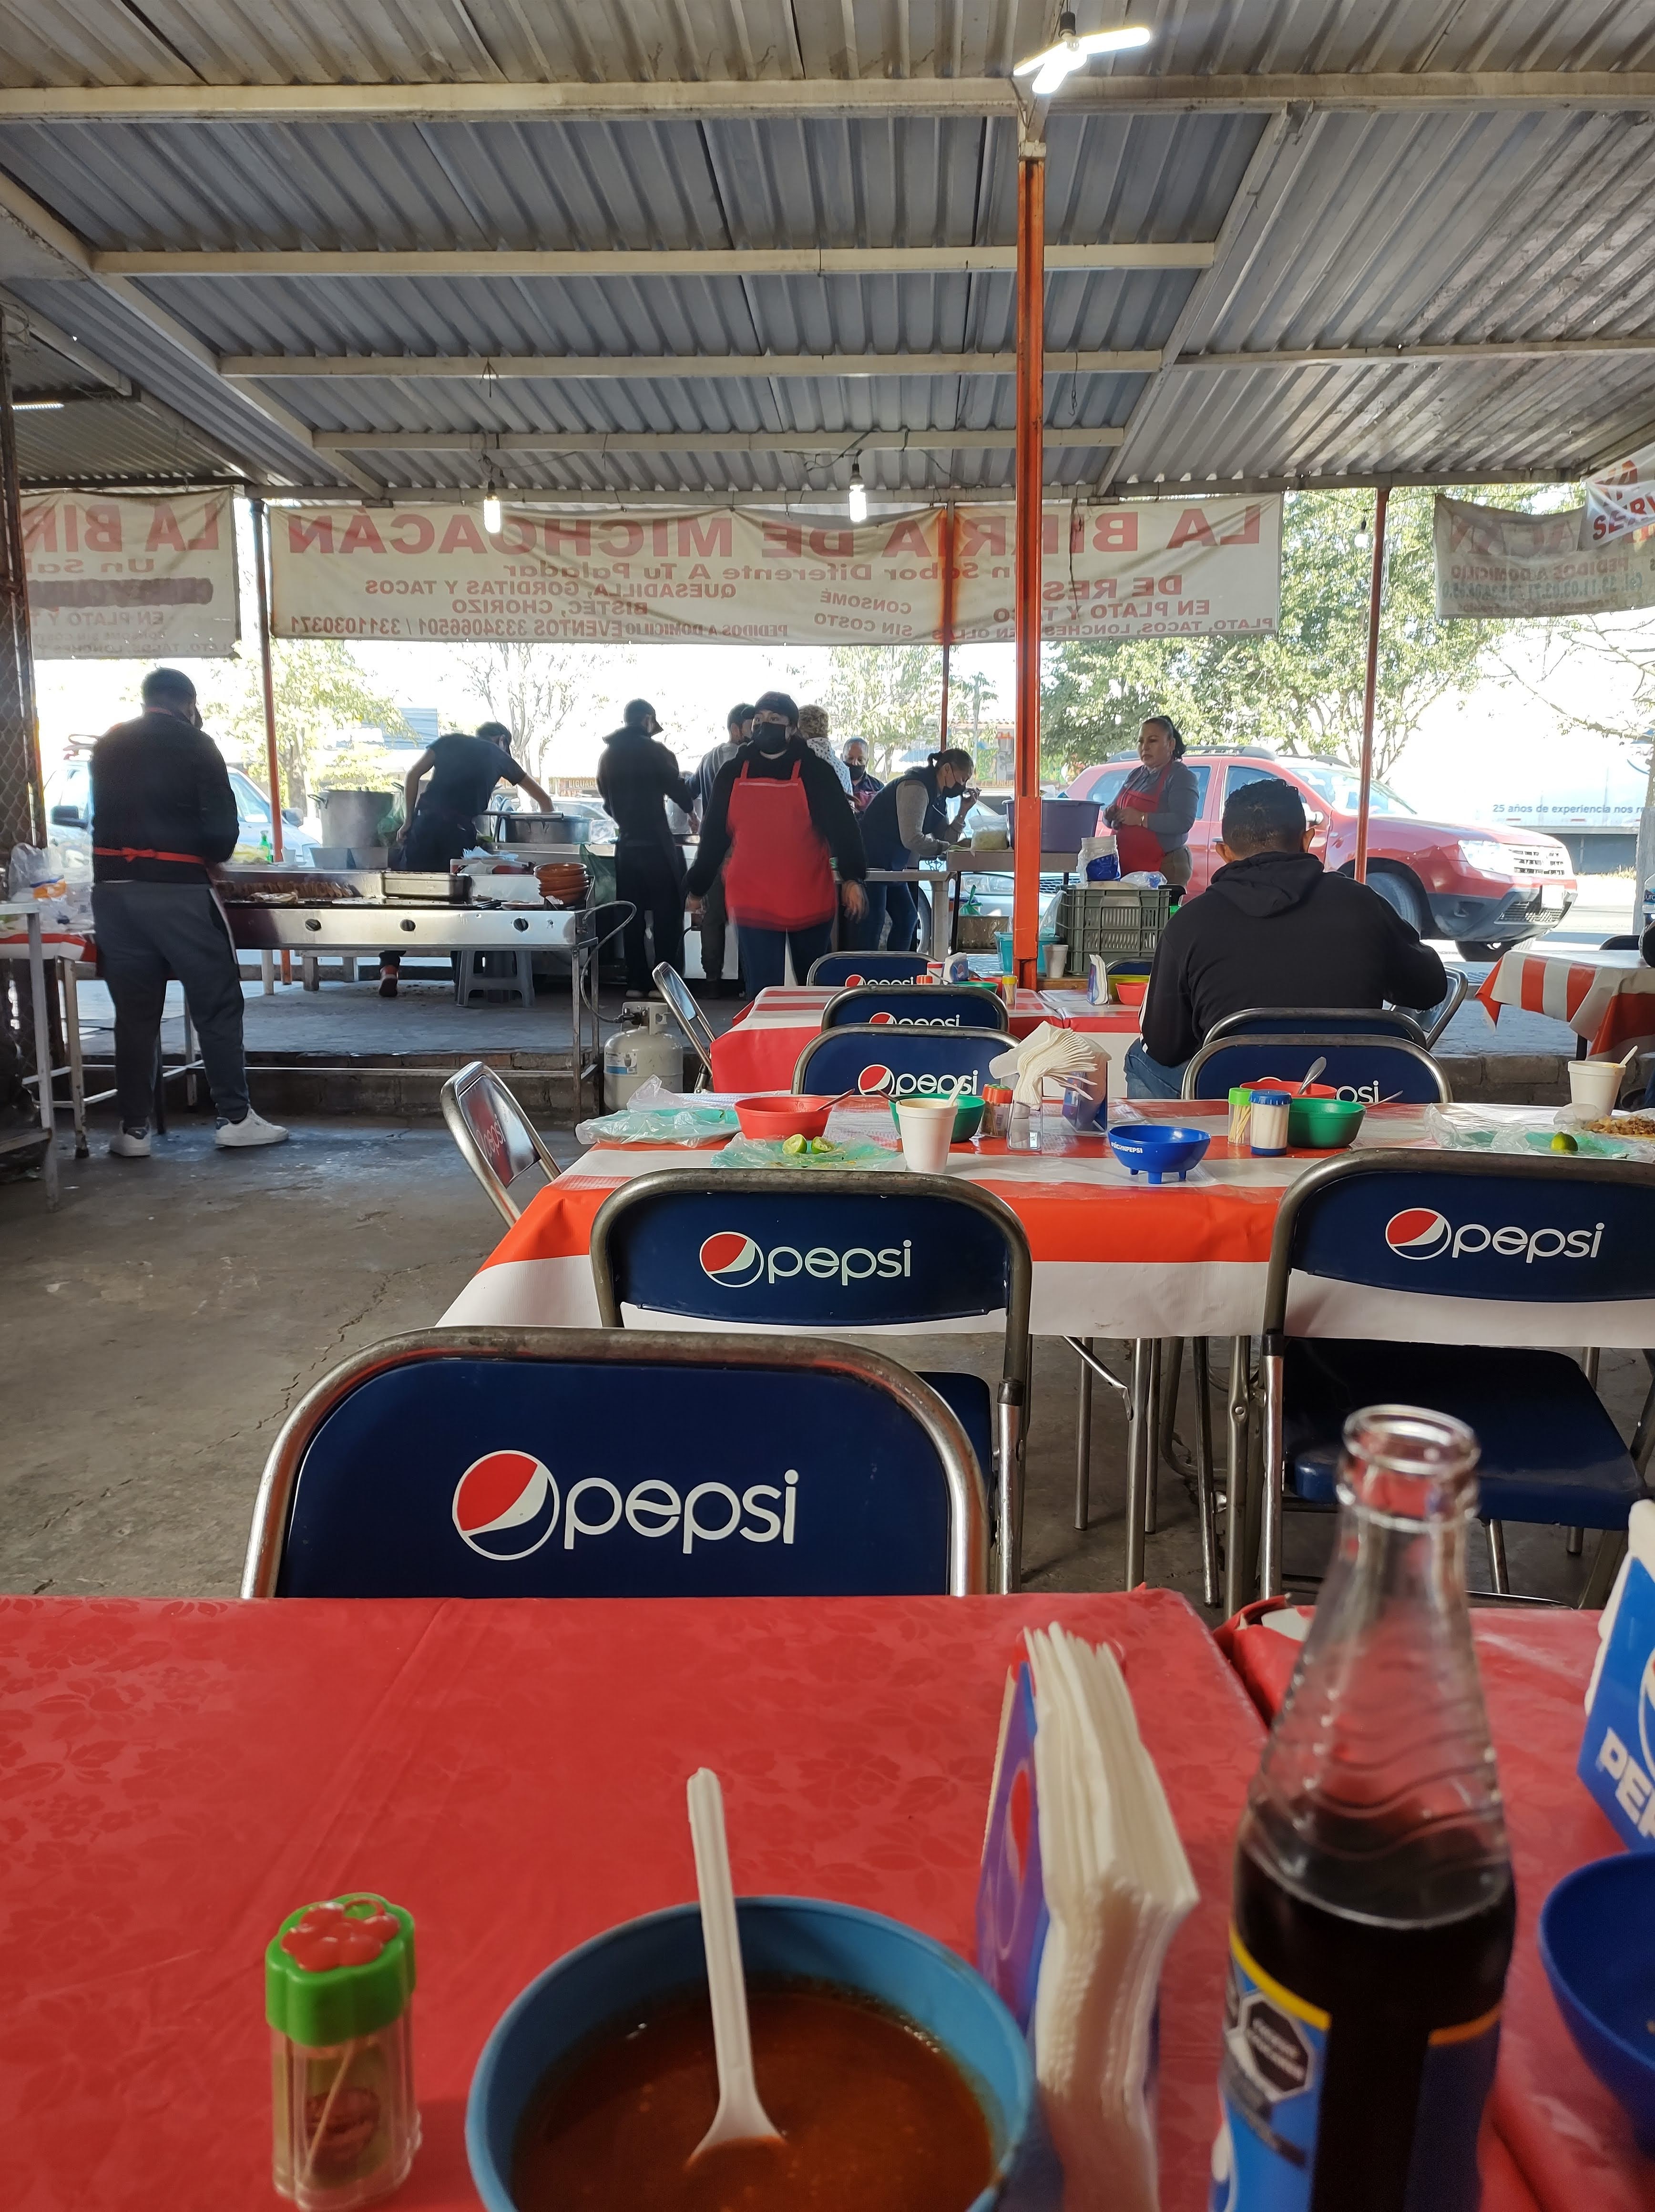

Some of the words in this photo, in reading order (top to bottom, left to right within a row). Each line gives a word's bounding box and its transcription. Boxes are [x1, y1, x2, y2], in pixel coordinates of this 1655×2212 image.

[1493, 804, 1505, 812] 25
[1507, 803, 1532, 813] años
[1536, 804, 1548, 813] de
[1552, 804, 1611, 815] experiencia
[896, 1069, 978, 1096] pepsi
[768, 1239, 912, 1286] pepsi
[1452, 1222, 1605, 1263] pepsi
[564, 1469, 799, 1554] pepsi
